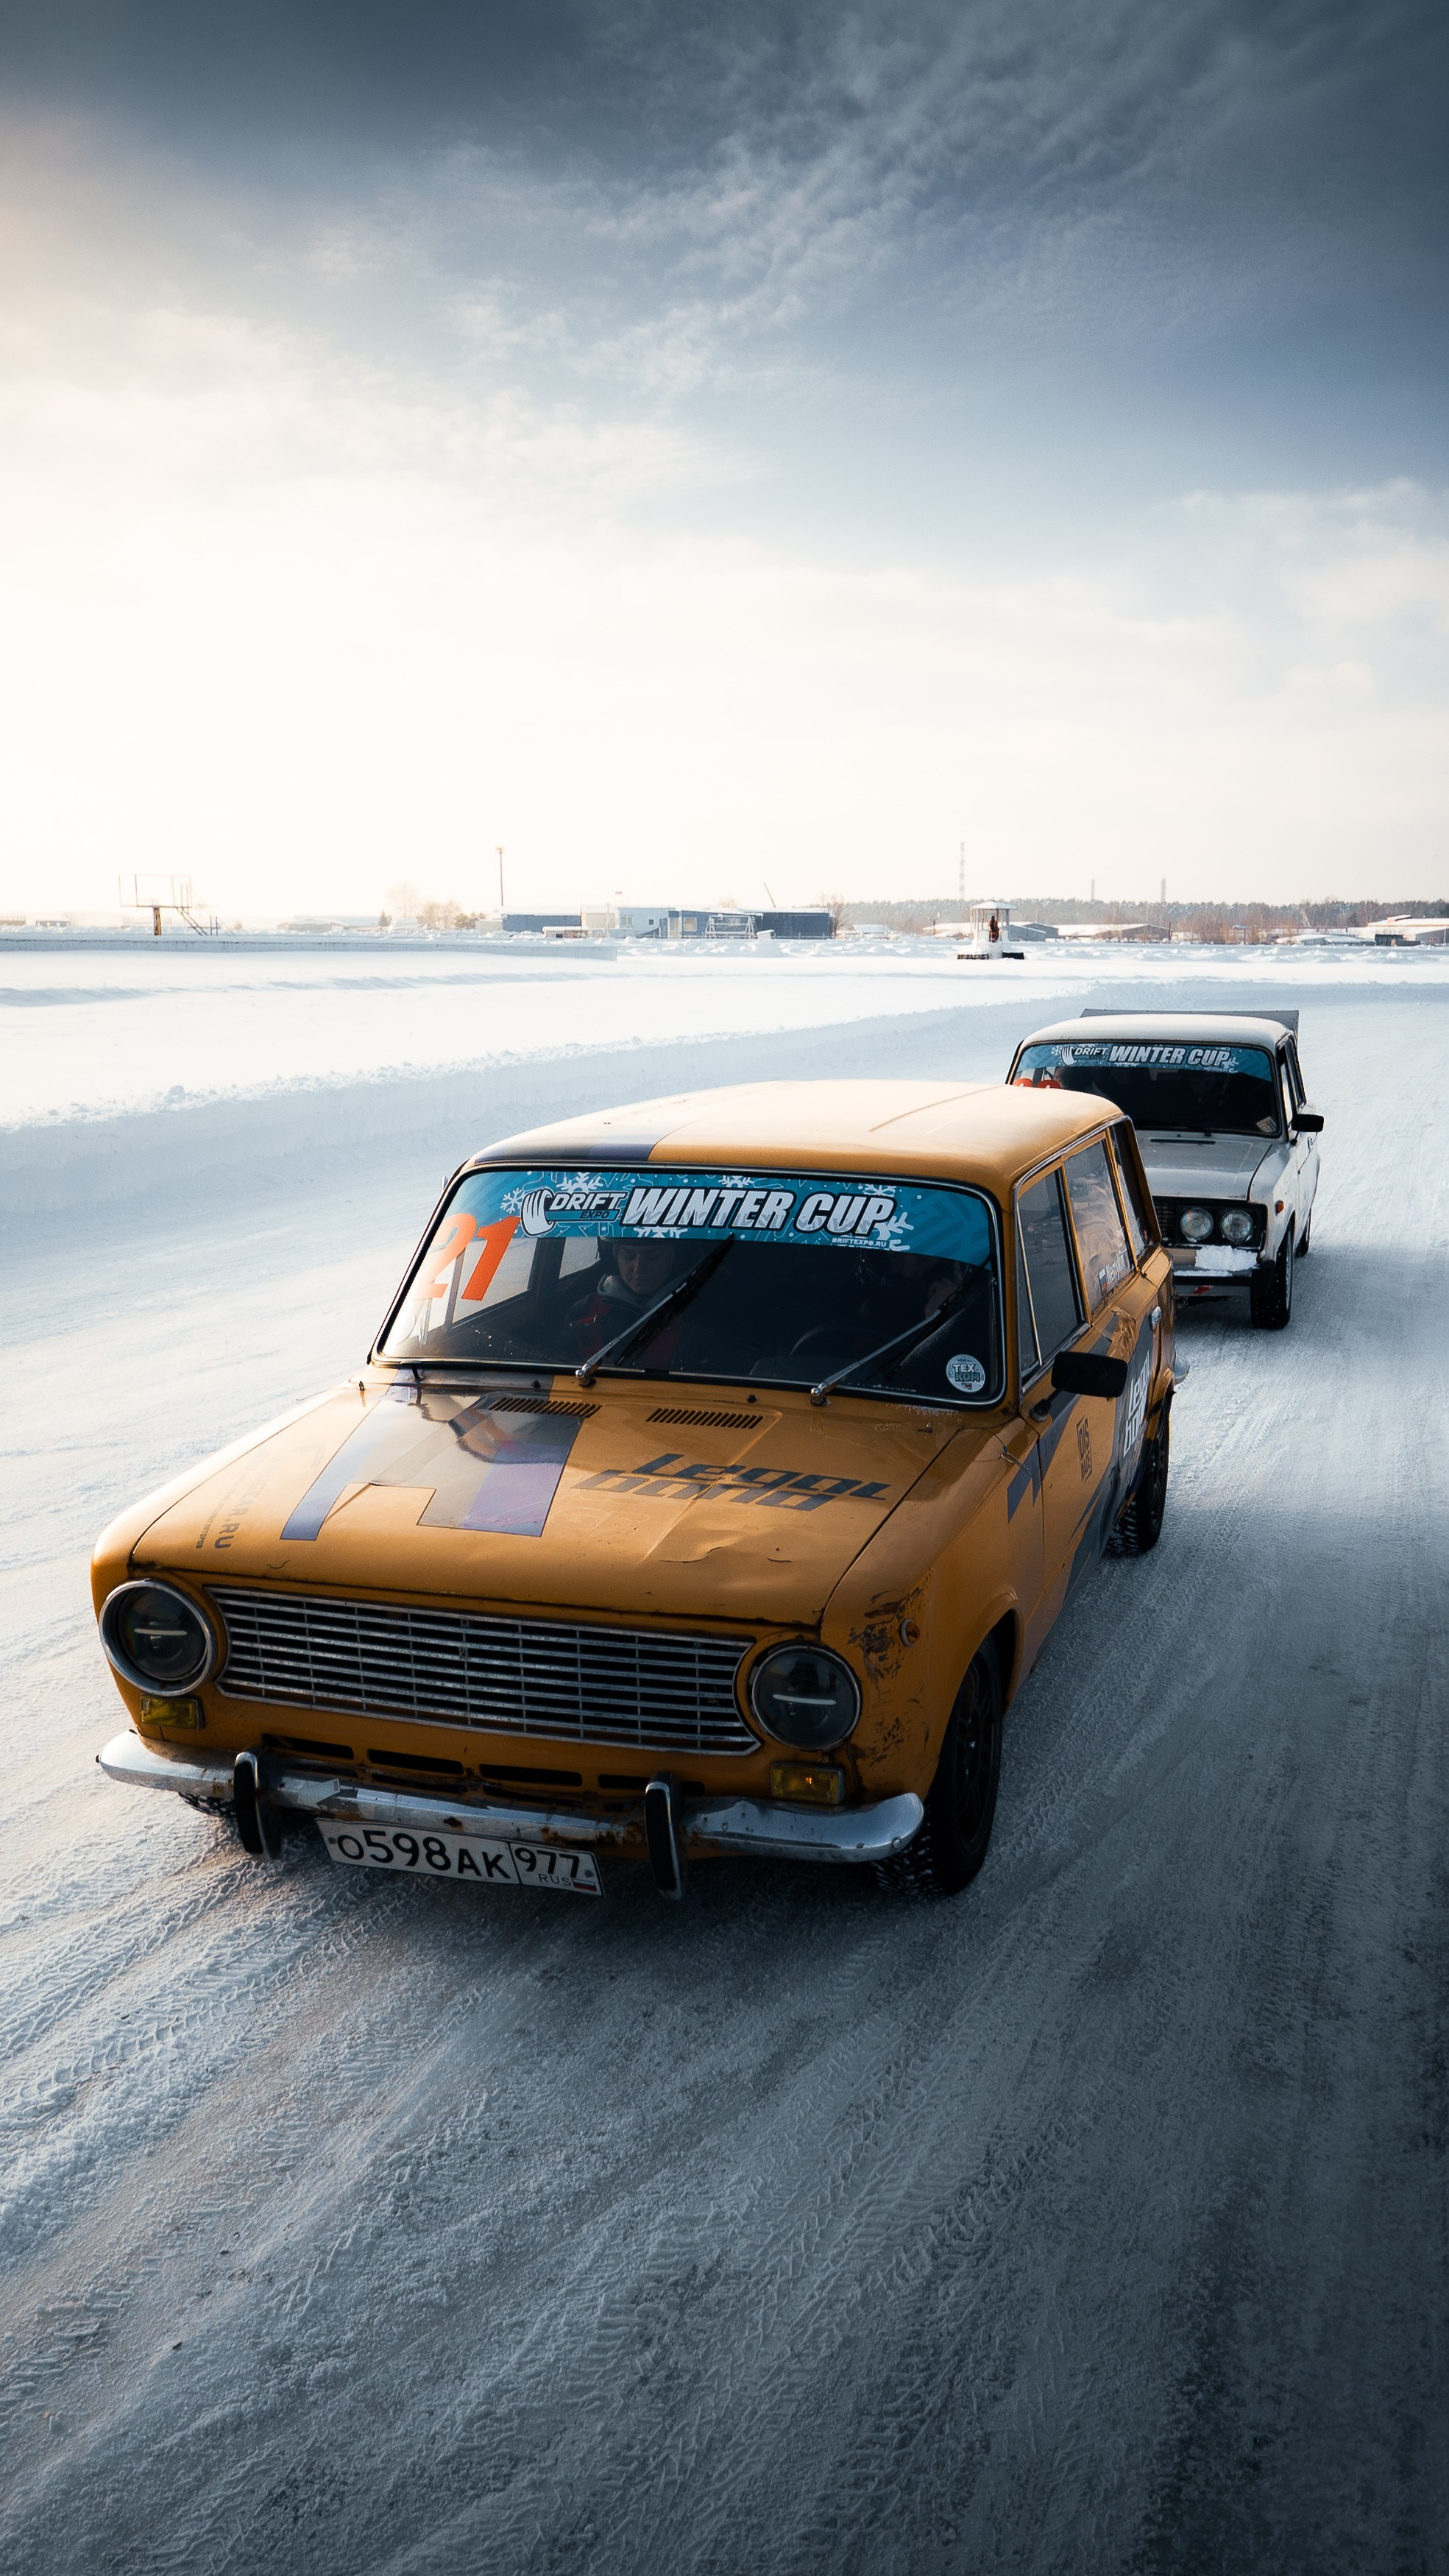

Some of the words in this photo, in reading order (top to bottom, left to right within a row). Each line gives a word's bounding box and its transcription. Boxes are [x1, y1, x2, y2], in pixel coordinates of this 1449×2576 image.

[1074, 1047, 1109, 1056] DRIFT
[1109, 1046, 1183, 1064] WINTER
[1187, 1048, 1231, 1066] CUP
[549, 1192, 627, 1211] DRIFT
[623, 1187, 795, 1230] WINTER
[796, 1192, 896, 1234] CUP
[579, 1211, 610, 1219] EXPO
[414, 1213, 521, 1301] 21
[514, 1847, 581, 1878] 977
[537, 1872, 572, 1886] RUS
